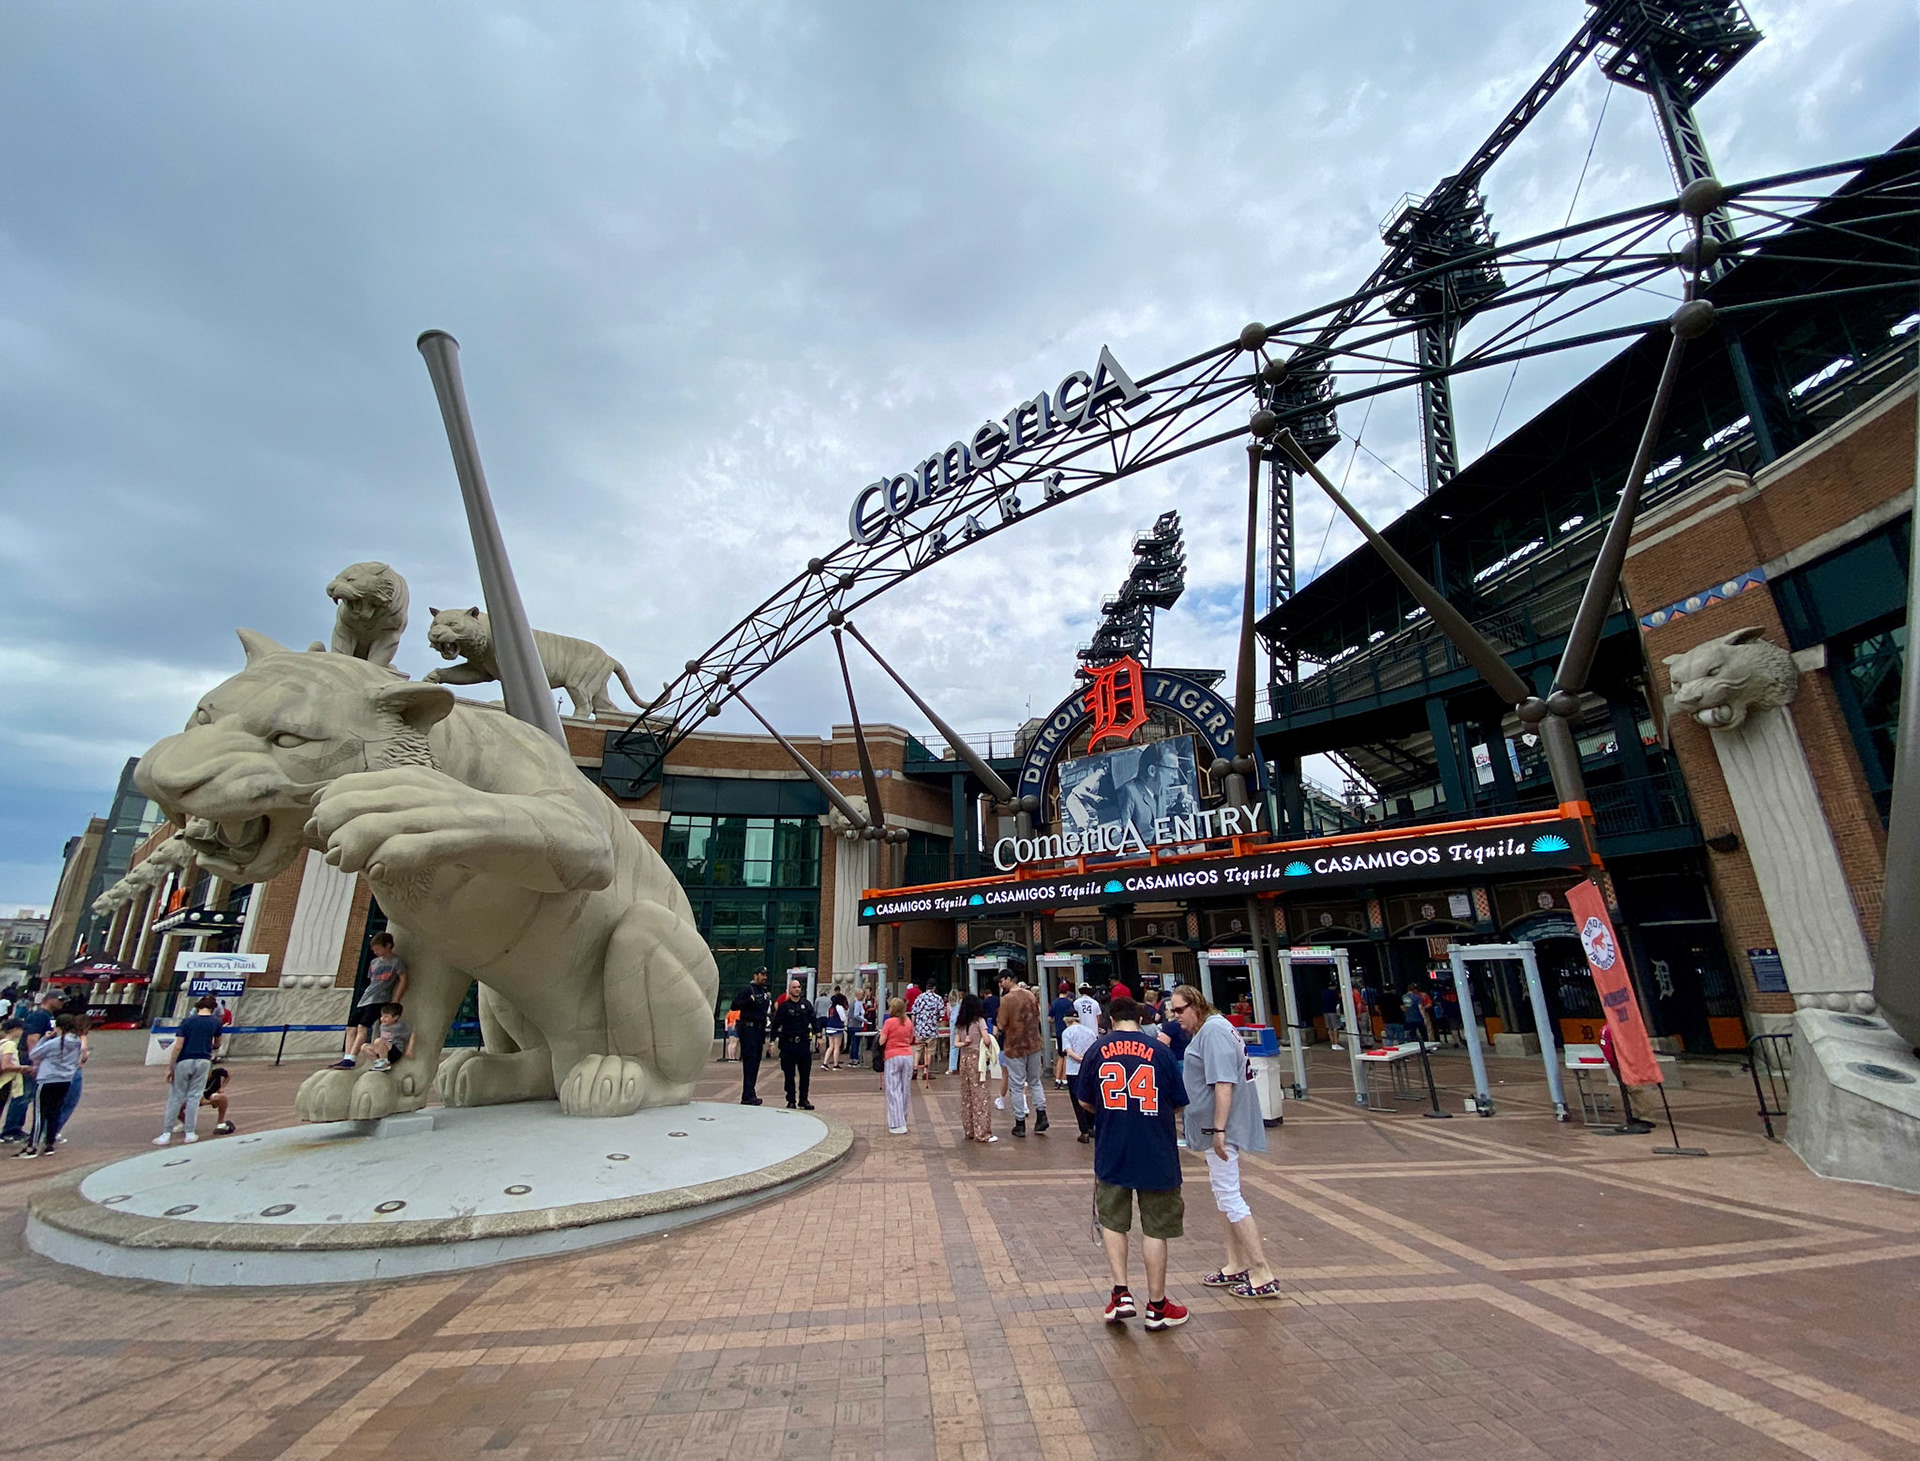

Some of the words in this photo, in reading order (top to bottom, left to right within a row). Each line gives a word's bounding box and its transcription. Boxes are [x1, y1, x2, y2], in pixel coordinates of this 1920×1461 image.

[929, 471, 1065, 553] PARK
[1083, 654, 1149, 756] D
[1024, 695, 1087, 783] DETROIT
[1154, 678, 1235, 746] TIGERS
[1155, 803, 1263, 846] ENTRY
[876, 899, 932, 916] CASAMIGOS
[934, 896, 968, 912] Tequila
[985, 886, 1056, 905] CASAMIGOS
[1059, 881, 1102, 899] Tequila
[1125, 870, 1219, 892] CASAMIGOS
[1223, 863, 1281, 884] Tequila
[1314, 847, 1441, 875] CASAMIGOS
[1448, 840, 1527, 863] Tequila
[192, 980, 208, 991] VIP
[220, 980, 244, 991] GATE
[233, 961, 257, 970] Bank
[1082, 1004, 1092, 1015] 24
[1100, 1040, 1154, 1062] CABRERA
[1099, 1062, 1158, 1113] 24
